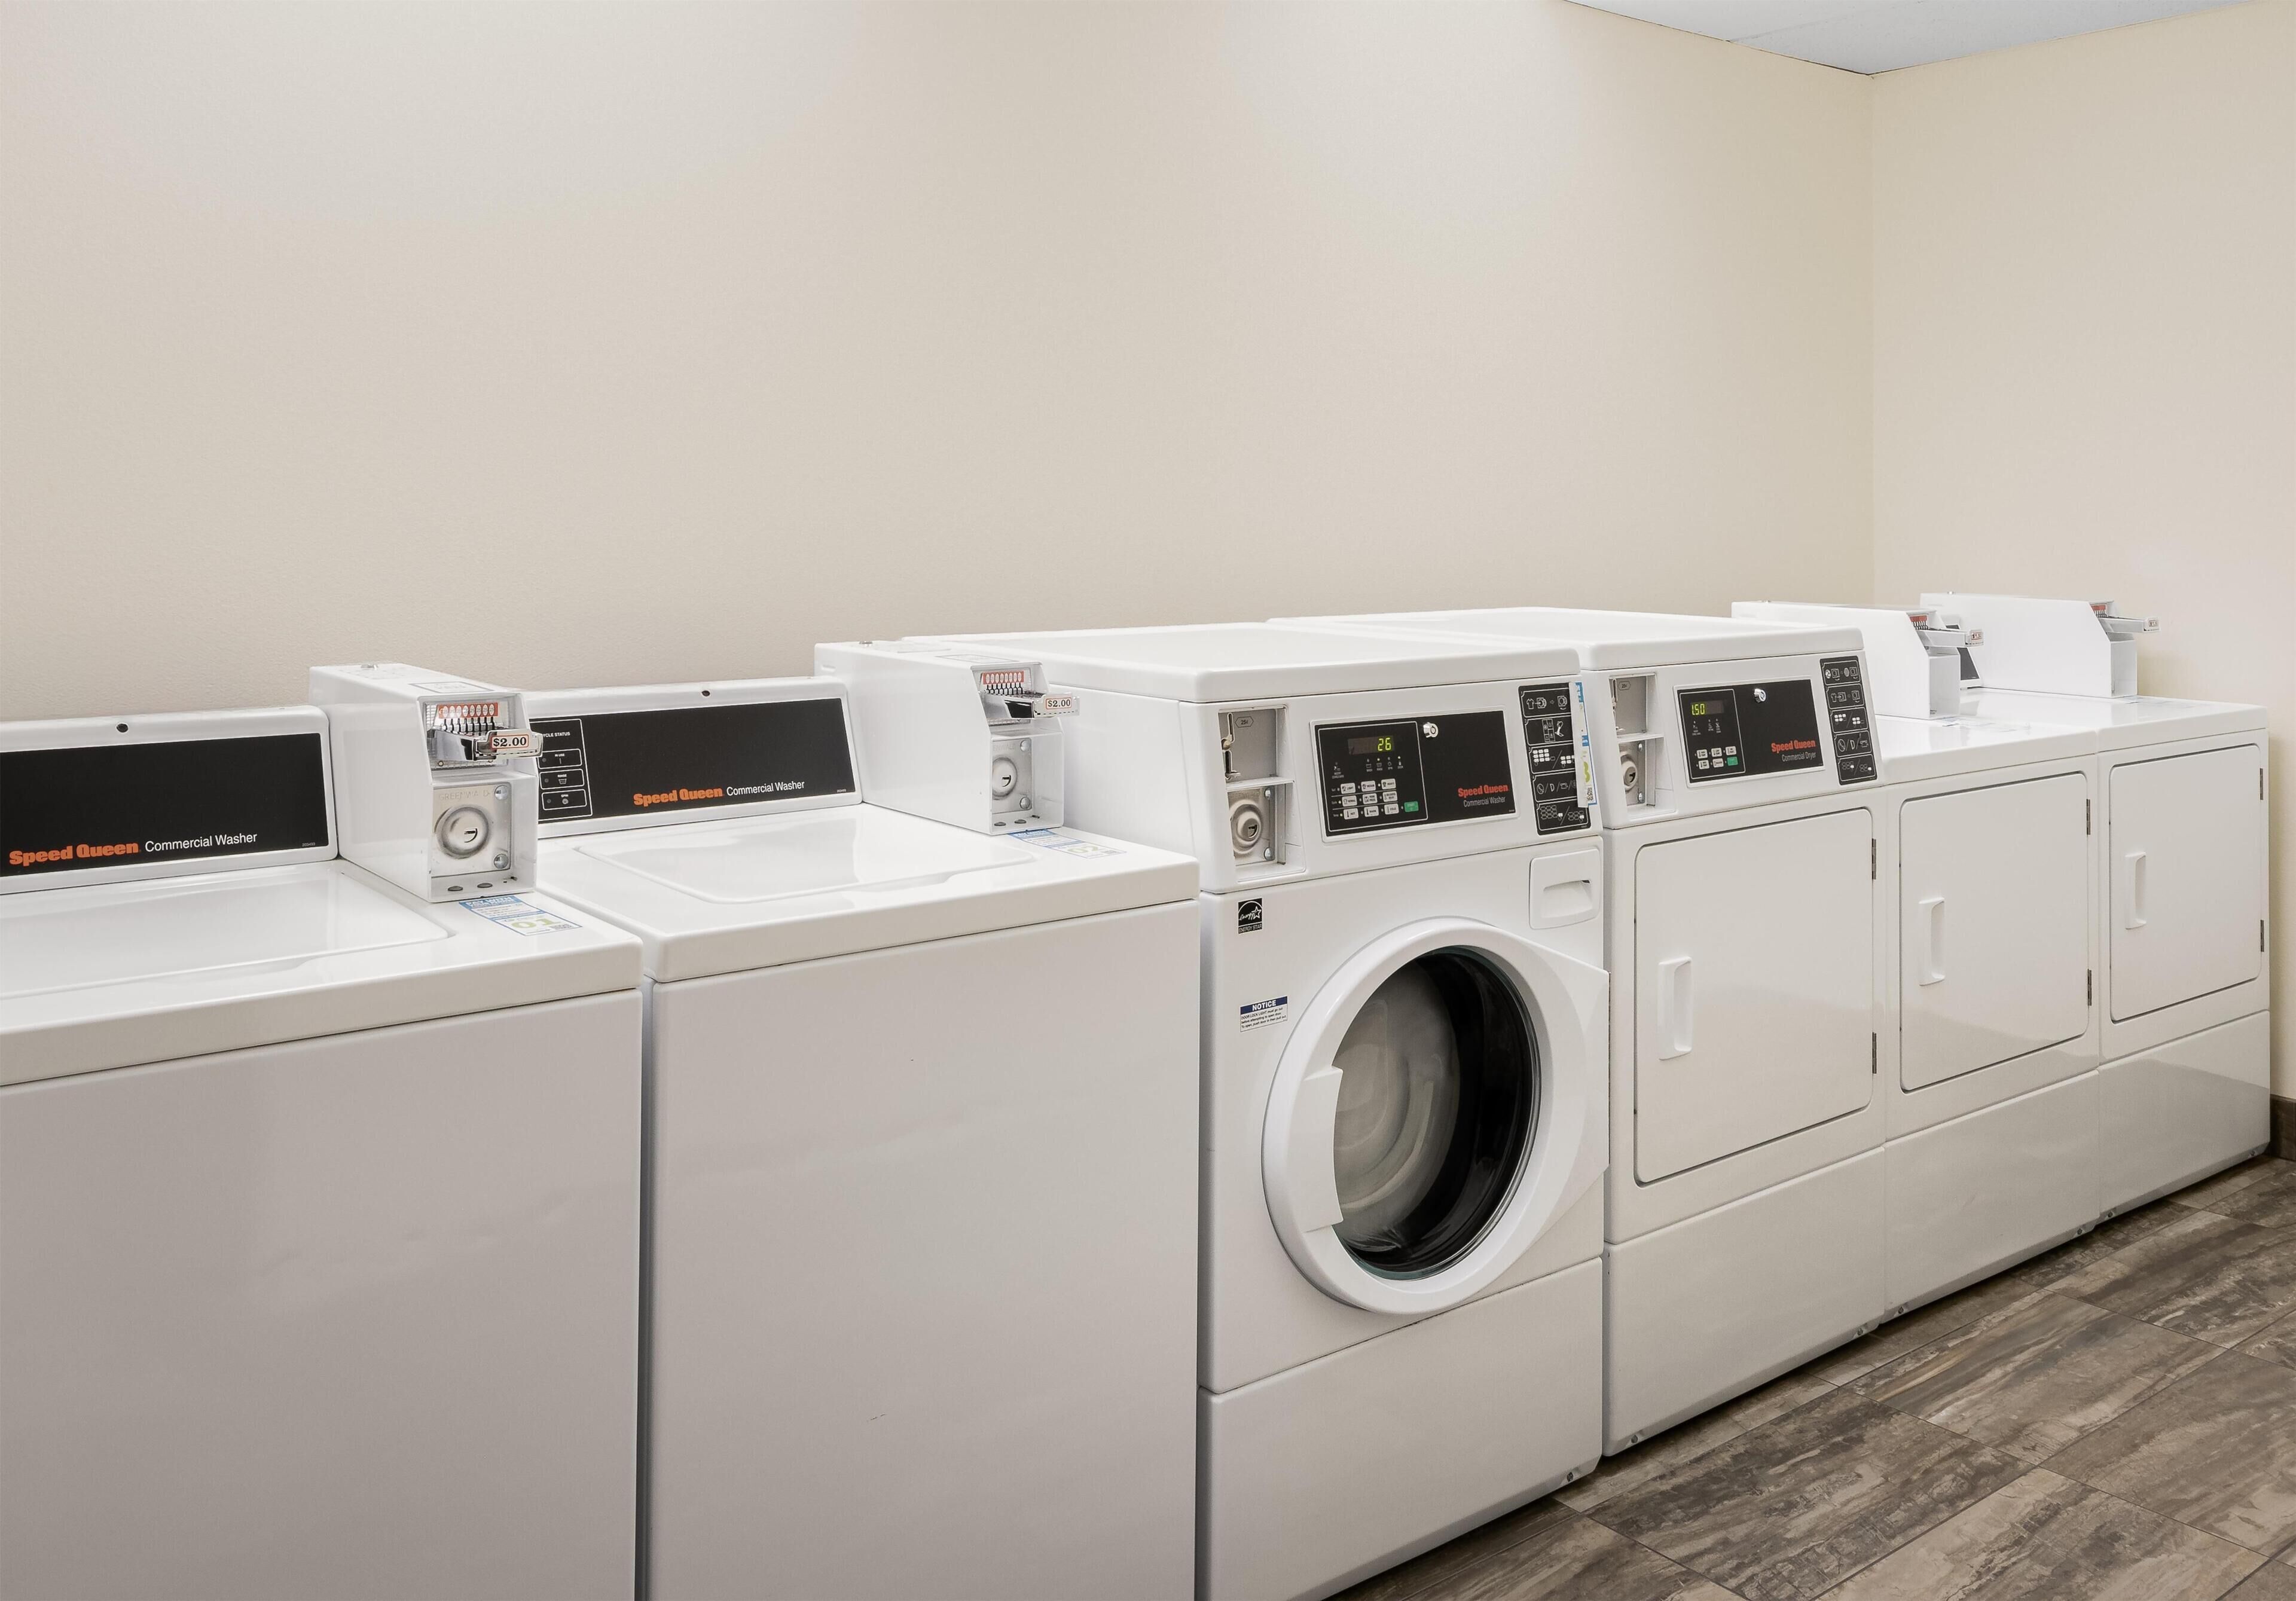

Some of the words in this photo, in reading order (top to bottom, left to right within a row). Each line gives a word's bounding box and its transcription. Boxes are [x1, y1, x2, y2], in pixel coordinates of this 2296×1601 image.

[1048, 699, 1071, 707] $2.00
[493, 737, 527, 747] $2.00
[1377, 737, 1391, 751] 26
[1771, 740, 1794, 754] Speed
[1794, 740, 1816, 749] Queen
[1782, 752, 1805, 762] Commercial
[1805, 751, 1816, 760] Dryer
[439, 789, 490, 800] GREENWAD
[633, 790, 678, 806] Speed
[679, 787, 723, 801] Queen
[726, 783, 774, 797] Commercial
[774, 780, 805, 792] Washer
[1458, 786, 1483, 798] Speed
[1483, 784, 1509, 794] Queen
[1464, 798, 1489, 807] Commercial
[1489, 796, 1506, 804] Washer
[9, 845, 73, 866] Speed
[77, 842, 139, 858] Queen
[145, 836, 212, 852] Commercial
[215, 833, 257, 846] Washer
[1252, 1000, 1277, 1011] NOTICE
